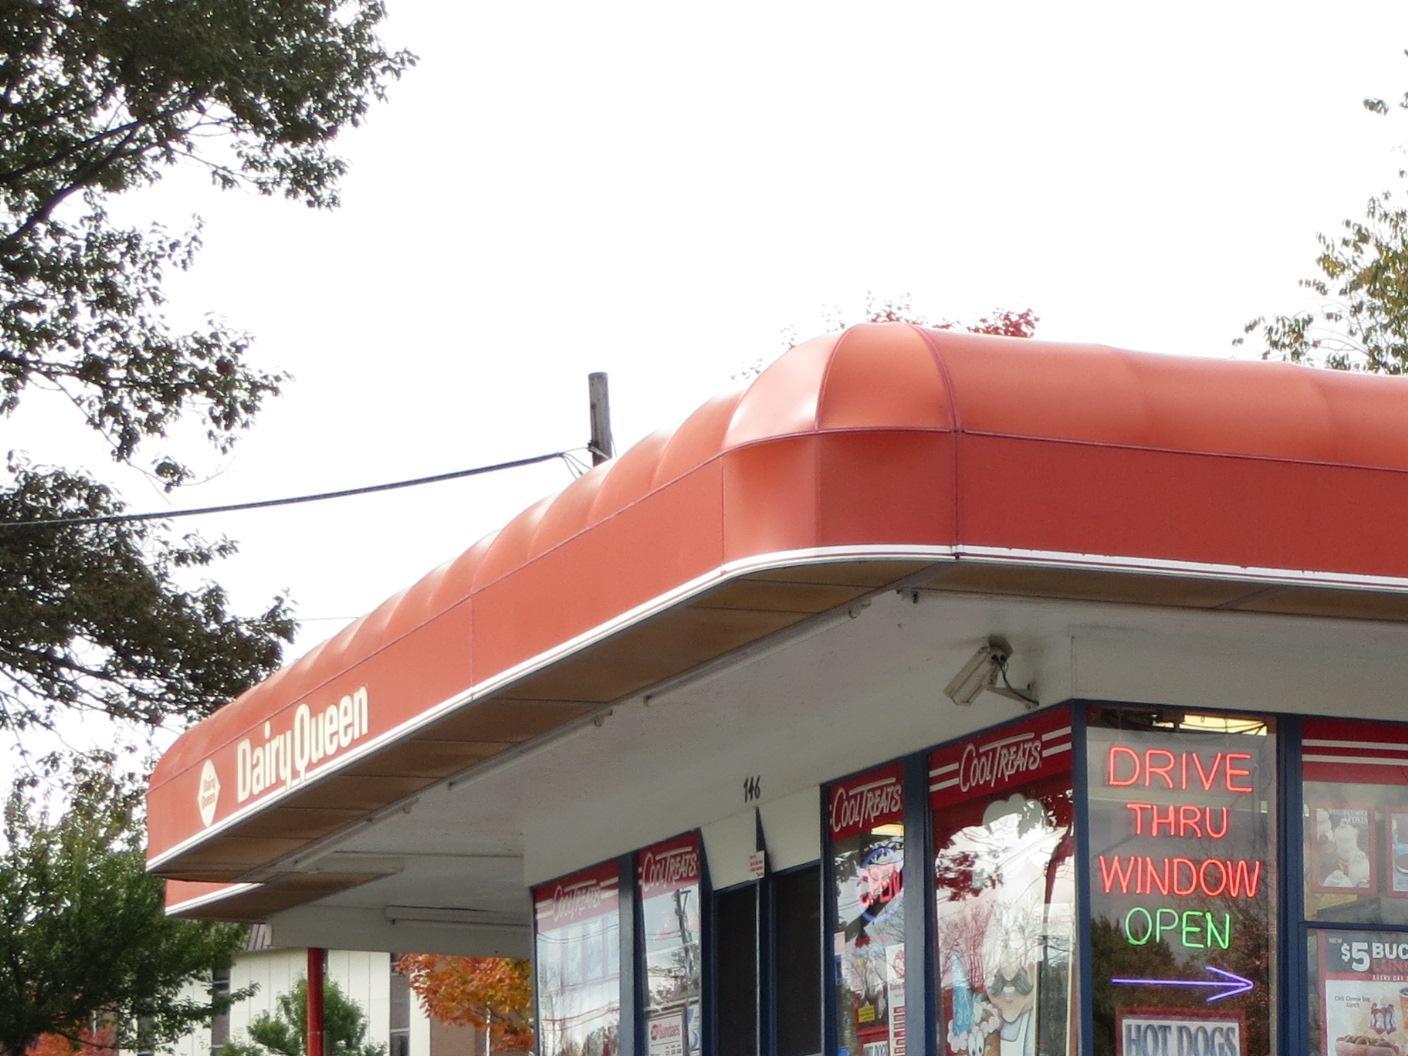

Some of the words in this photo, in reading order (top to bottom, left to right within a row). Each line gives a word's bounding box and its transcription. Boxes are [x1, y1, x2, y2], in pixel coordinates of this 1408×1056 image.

[236, 720, 292, 804] Dairy
[294, 686, 369, 781] Queen
[743, 775, 761, 803] 146
[1108, 746, 1254, 793] DRIVE
[1126, 802, 1229, 839] THRU
[1098, 854, 1261, 898] WINDOW
[1125, 906, 1230, 950] OPEN
[1340, 941, 1371, 972] $5
